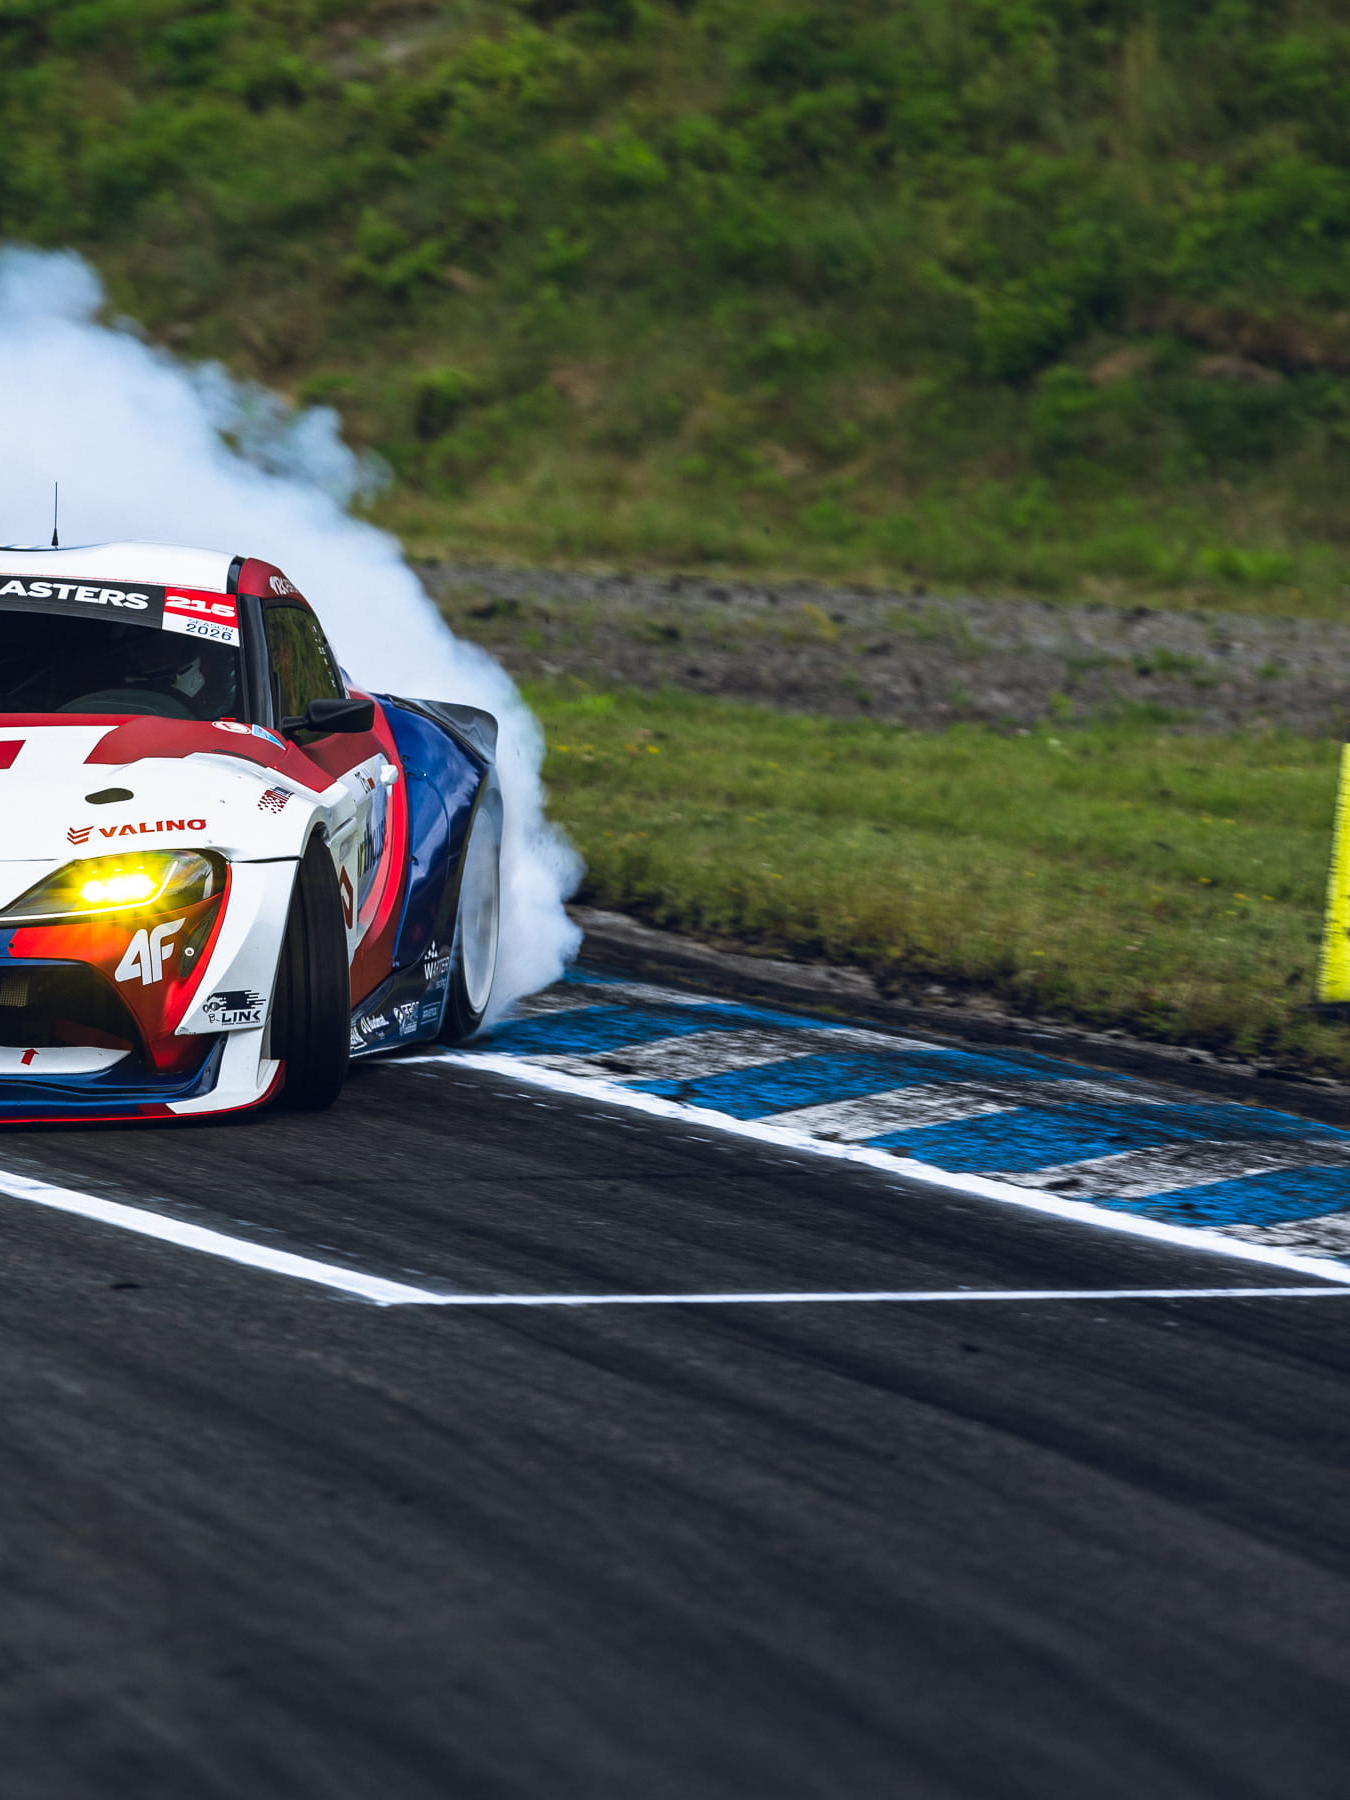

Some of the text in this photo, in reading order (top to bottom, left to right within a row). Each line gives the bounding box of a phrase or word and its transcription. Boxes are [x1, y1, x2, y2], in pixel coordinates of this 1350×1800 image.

[165, 595, 236, 618] 215
[185, 623, 232, 641] 2026
[188, 618, 234, 633] SEASON
[98, 819, 207, 838] VALINO
[114, 917, 187, 986] 4F
[221, 1010, 261, 1023] LINK
